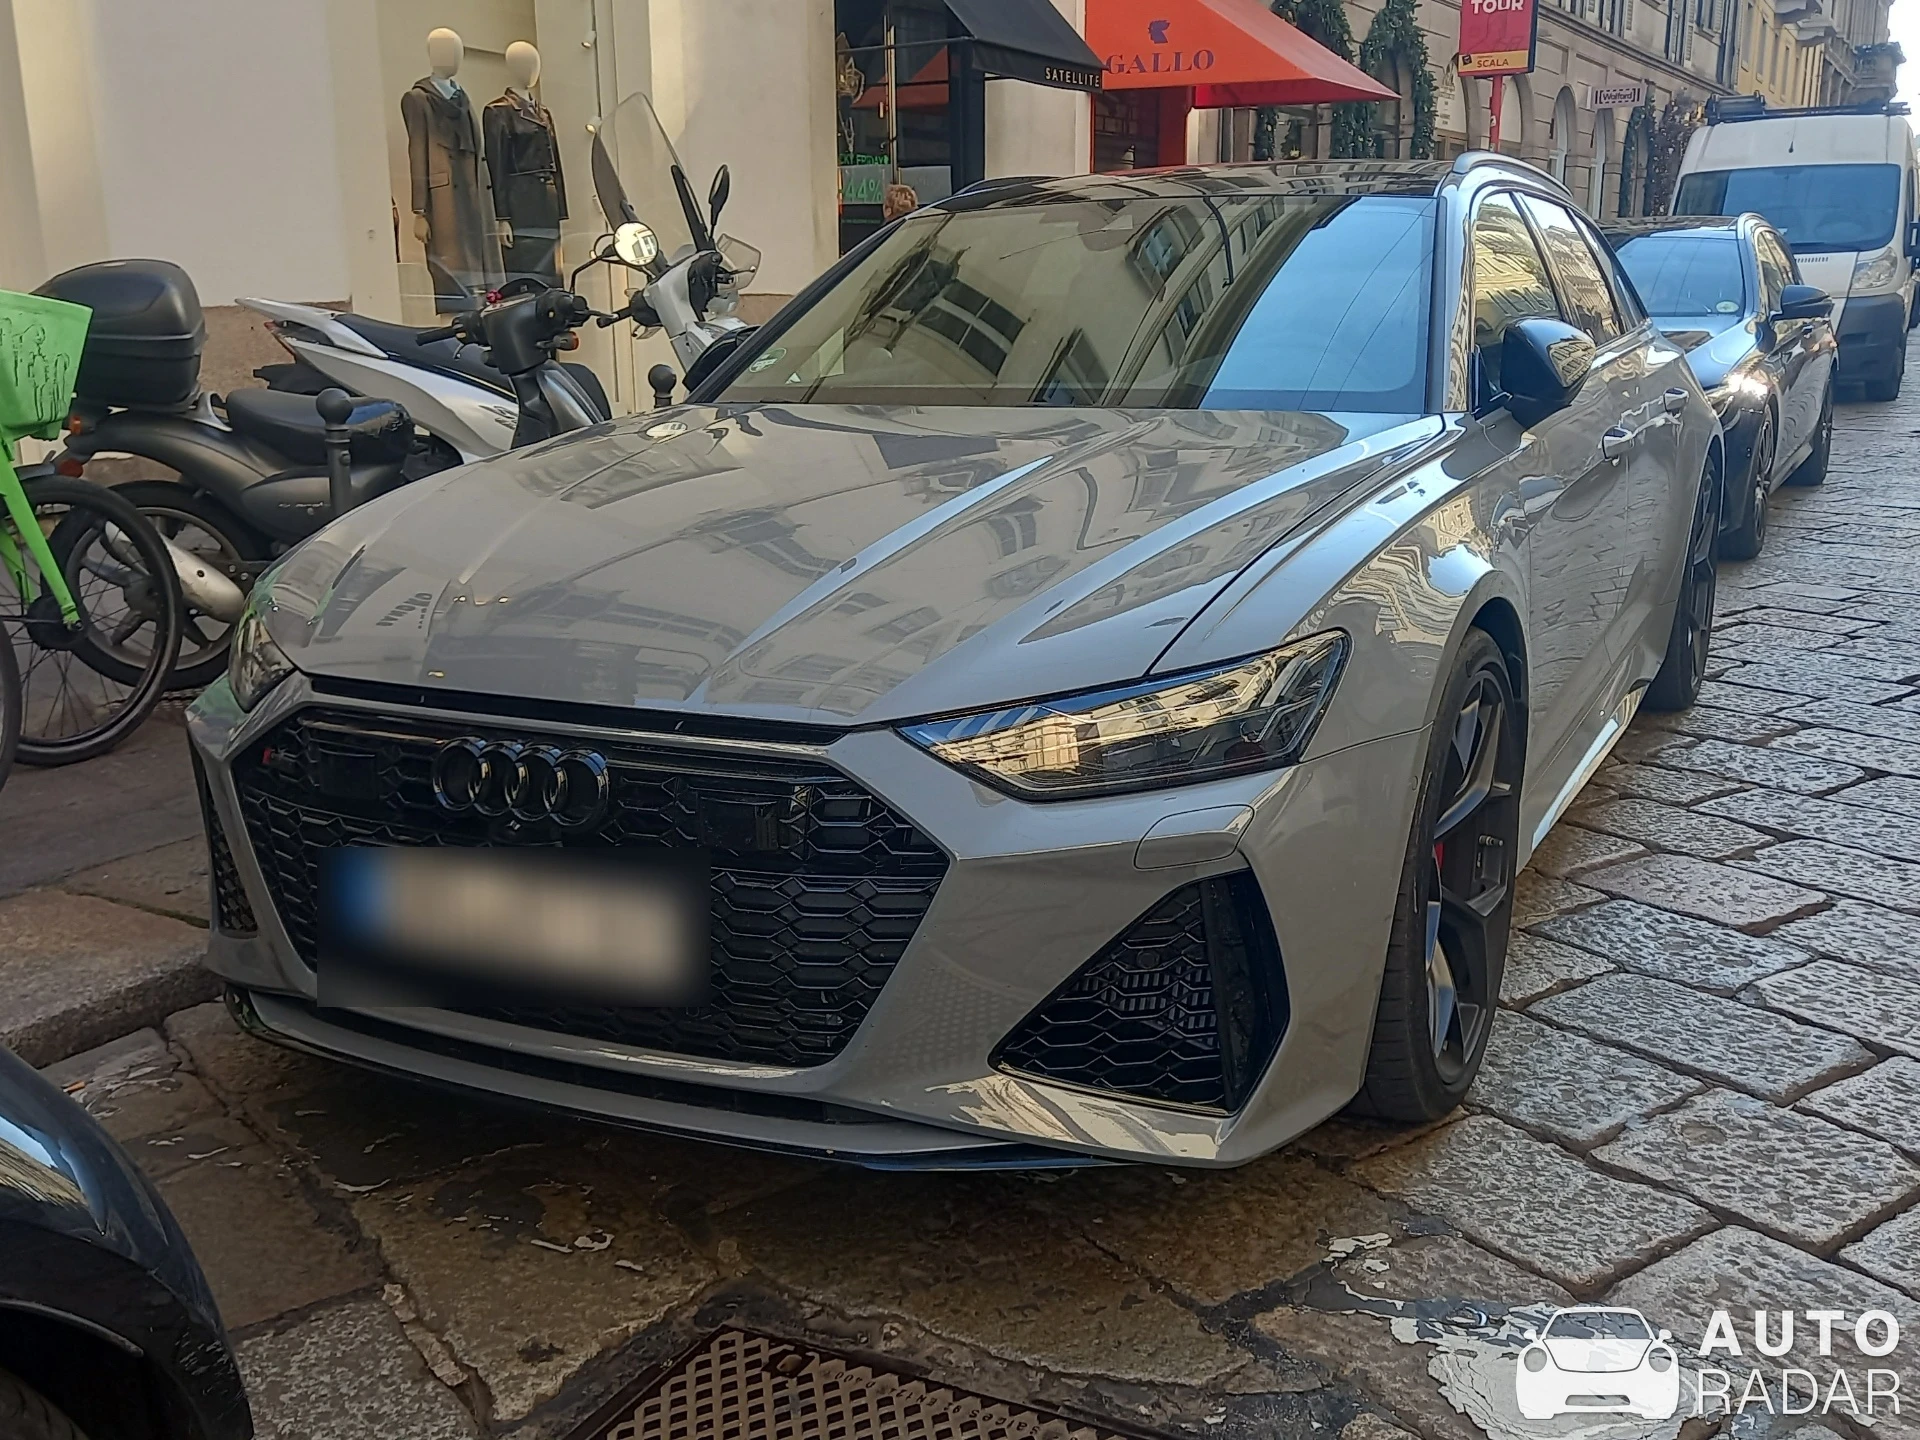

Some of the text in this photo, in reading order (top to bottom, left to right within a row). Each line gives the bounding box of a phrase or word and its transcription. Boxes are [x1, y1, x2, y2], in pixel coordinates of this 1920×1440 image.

[1471, 0, 1524, 14] TOUR
[1105, 49, 1214, 74] GALLO
[1477, 59, 1509, 68] SCALA
[1045, 67, 1100, 88] SATELLITE
